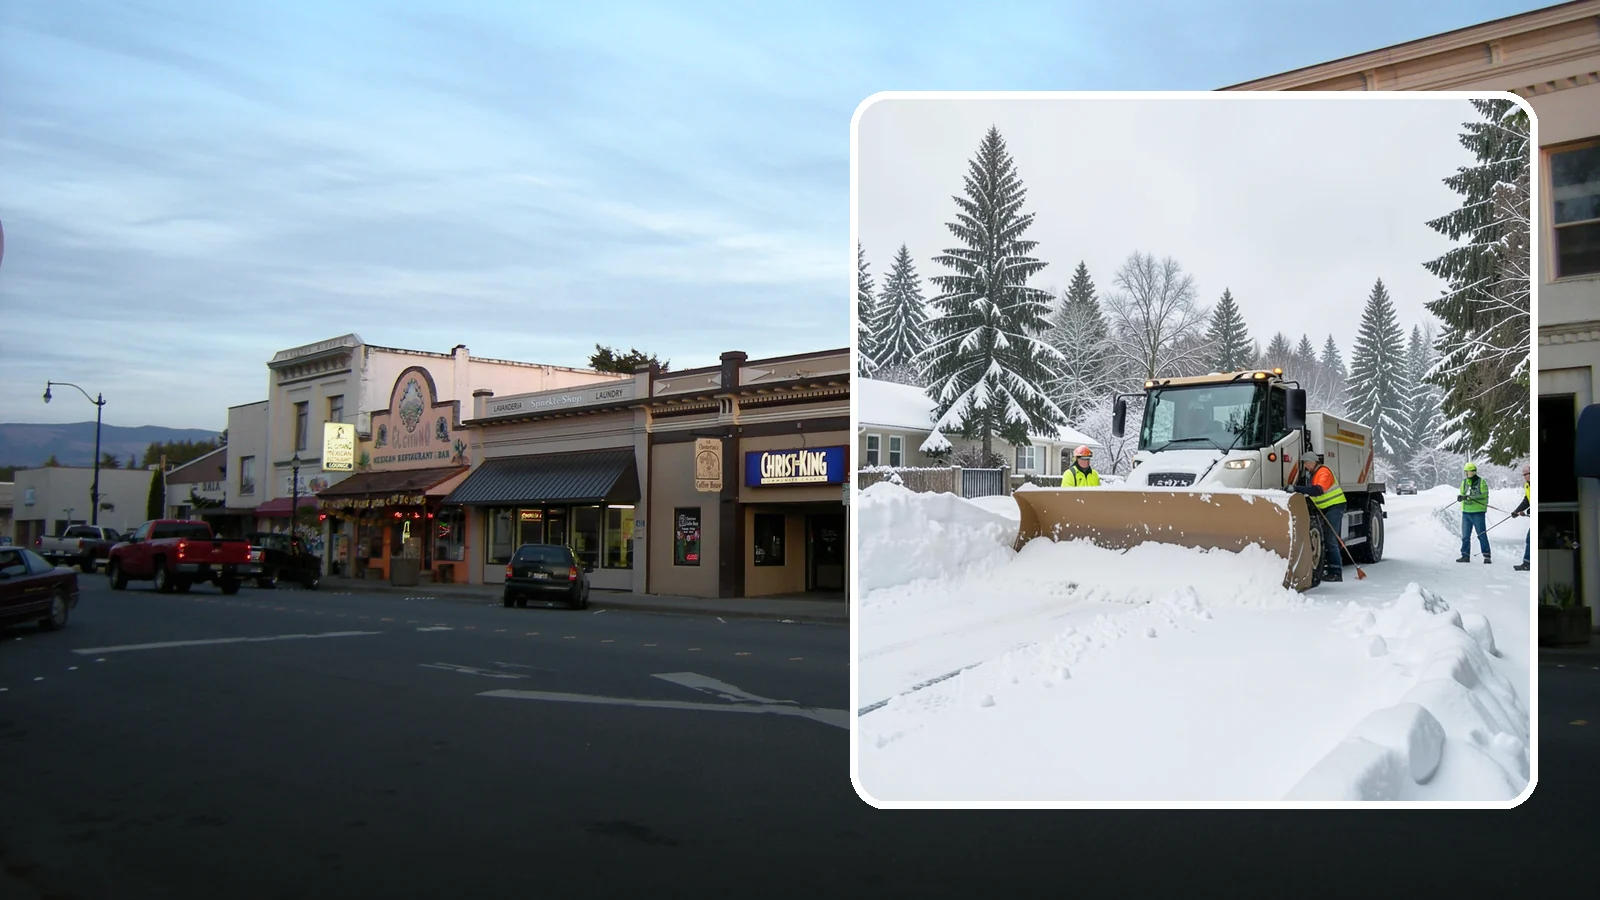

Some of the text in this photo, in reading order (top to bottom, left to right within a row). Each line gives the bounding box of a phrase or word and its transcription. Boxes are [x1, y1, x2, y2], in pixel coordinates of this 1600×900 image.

[562, 394, 582, 404] Shop
[596, 389, 624, 400] LAUNDRY
[494, 402, 522, 412] LAVANDERIA
[374, 455, 396, 464] MEXICAN
[398, 452, 433, 462] RESTAURANT
[438, 450, 450, 459] BAR
[761, 450, 827, 477] CHRIST KING
